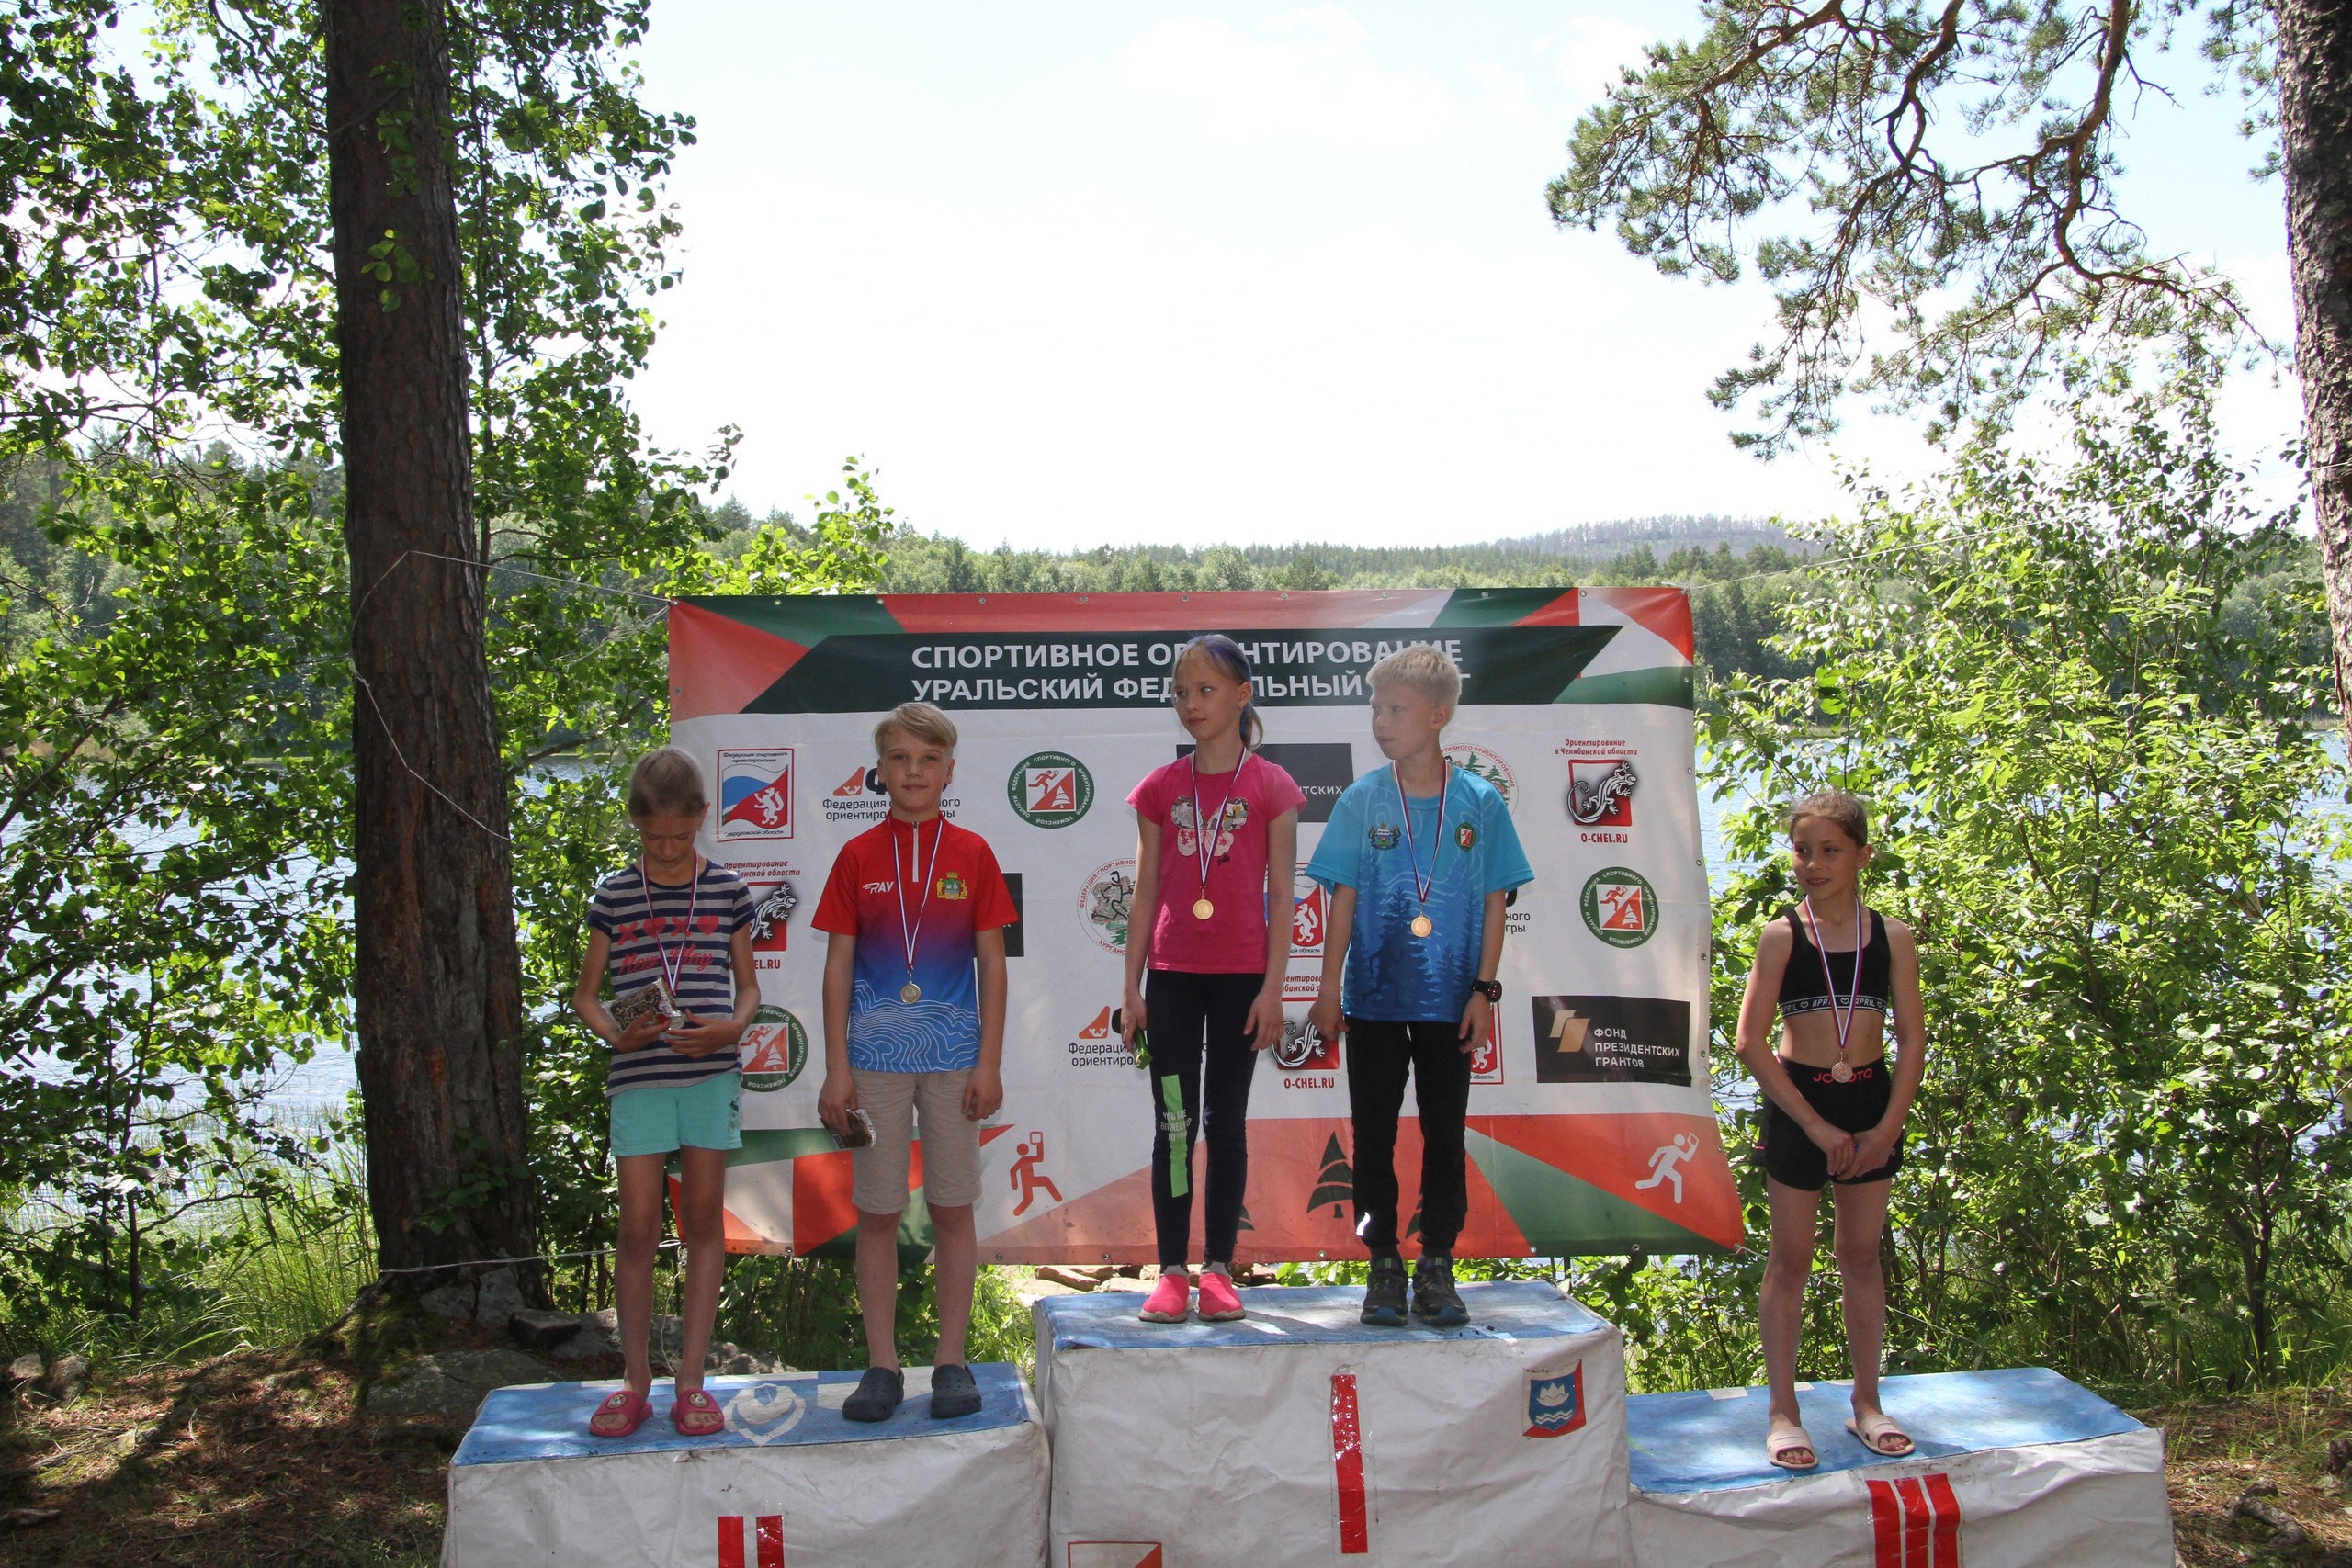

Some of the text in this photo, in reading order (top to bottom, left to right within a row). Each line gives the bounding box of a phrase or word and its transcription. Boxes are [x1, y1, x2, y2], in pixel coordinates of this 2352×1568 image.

[911, 639, 1463, 669] СПОРТИВНОЕ ОРНТИРОВАЕ
[911, 670, 1363, 703] УРАЛЬСКИЙ ФЕДЛЬНЫЙ
[1566, 739, 1626, 748] Ориентирование
[1561, 748, 1606, 756] Челябинской
[1608, 748, 1638, 756] области
[1442, 745, 1516, 787] РТИВНОГО ОРИЕНТИРОВАНИЯ
[1012, 761, 1031, 791] ФЕДЕРАЦИЯ
[1034, 754, 1076, 767] СПОРТИВНОГО
[1077, 767, 1091, 816] ОРИЕНТИРОВАНИЯ
[822, 798, 887, 811] Федерация
[826, 810, 887, 821] ориентиро
[1580, 833, 1628, 843] O-CHEL.RU
[1080, 860, 1137, 908] ФЕДЕРАЦИЯ СПОРТИВНОГ
[1602, 871, 1642, 885] СПОРТИВНОГО
[1812, 998, 1832, 1008] APRI
[1594, 1028, 1627, 1040] ФОНД
[1069, 1042, 1130, 1055] Федераци
[1595, 1043, 1680, 1057] ПРЕЗИДЕНТСКИХ
[1072, 1056, 1136, 1068] ориентиро
[1596, 1057, 1645, 1068] ГРАНТОВ
[1284, 1078, 1335, 1089] O-CHEL.RU
